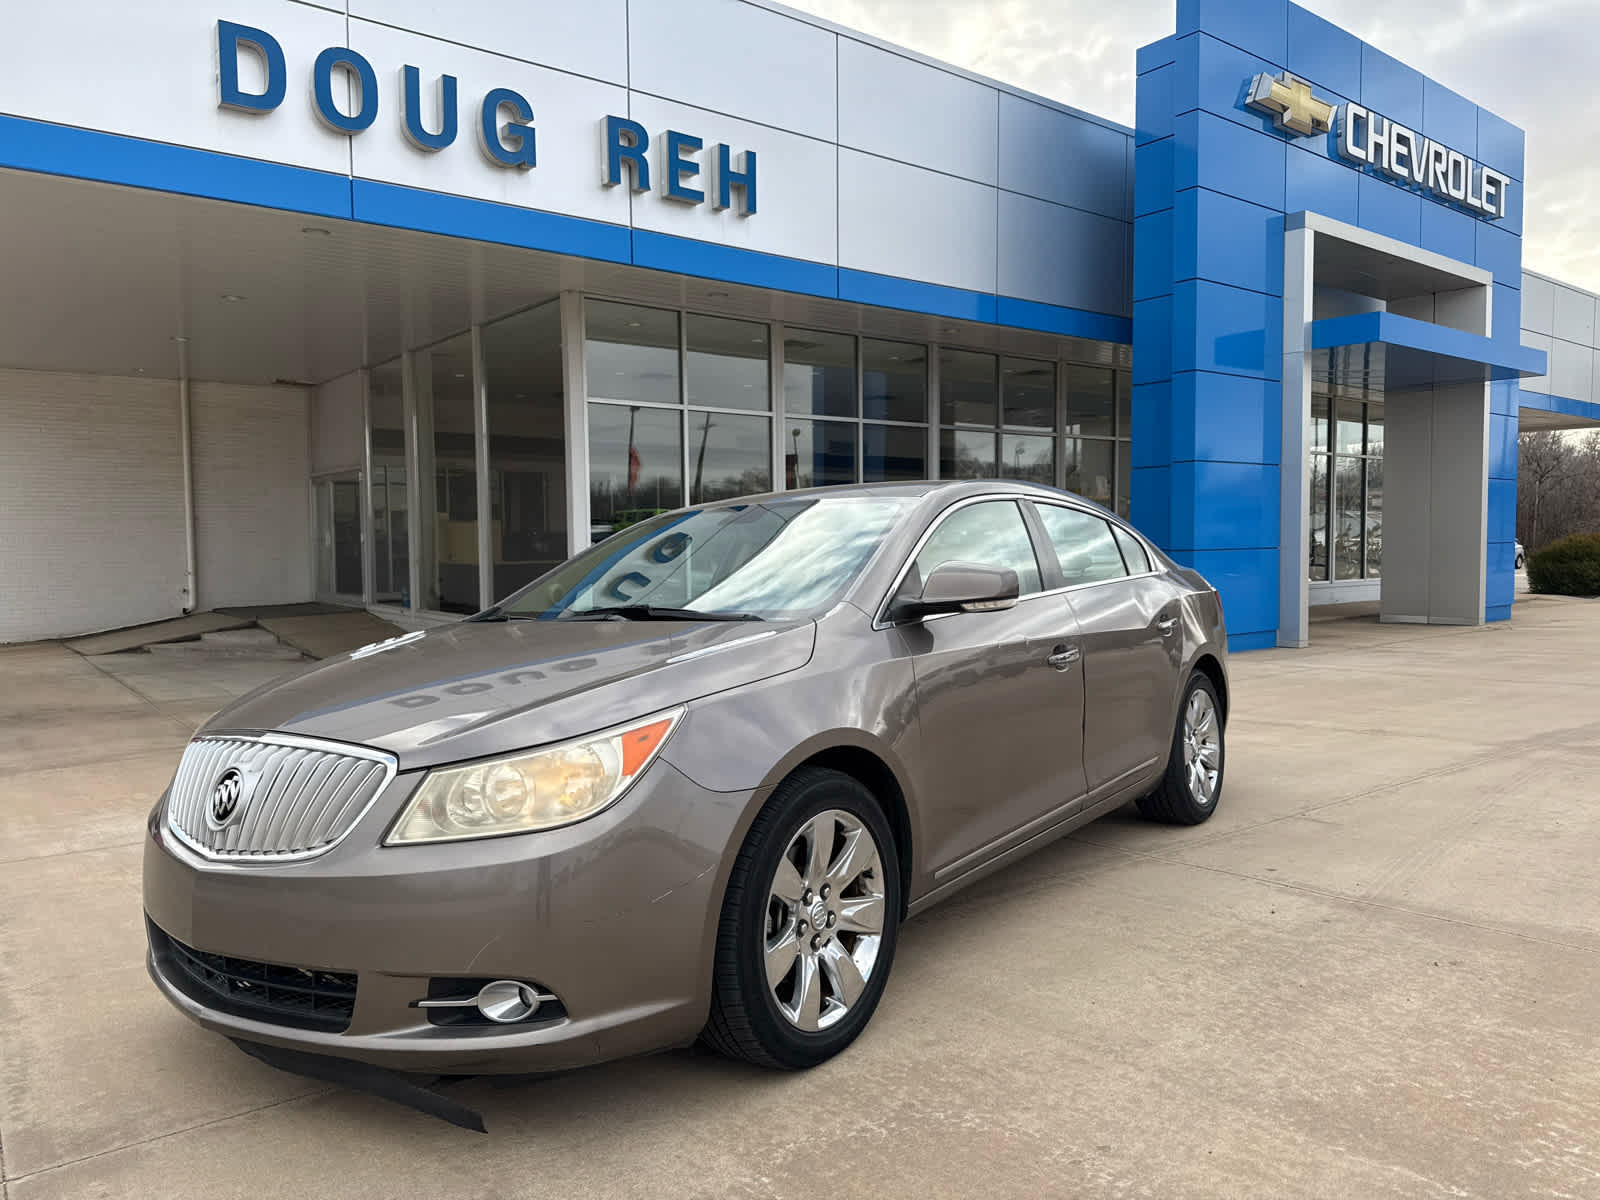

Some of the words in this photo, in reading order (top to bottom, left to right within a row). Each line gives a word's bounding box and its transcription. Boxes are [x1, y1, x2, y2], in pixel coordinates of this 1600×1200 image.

[215, 19, 537, 170] DOUG
[601, 115, 757, 217] REH
[1341, 101, 1510, 218] CHEVROLET
